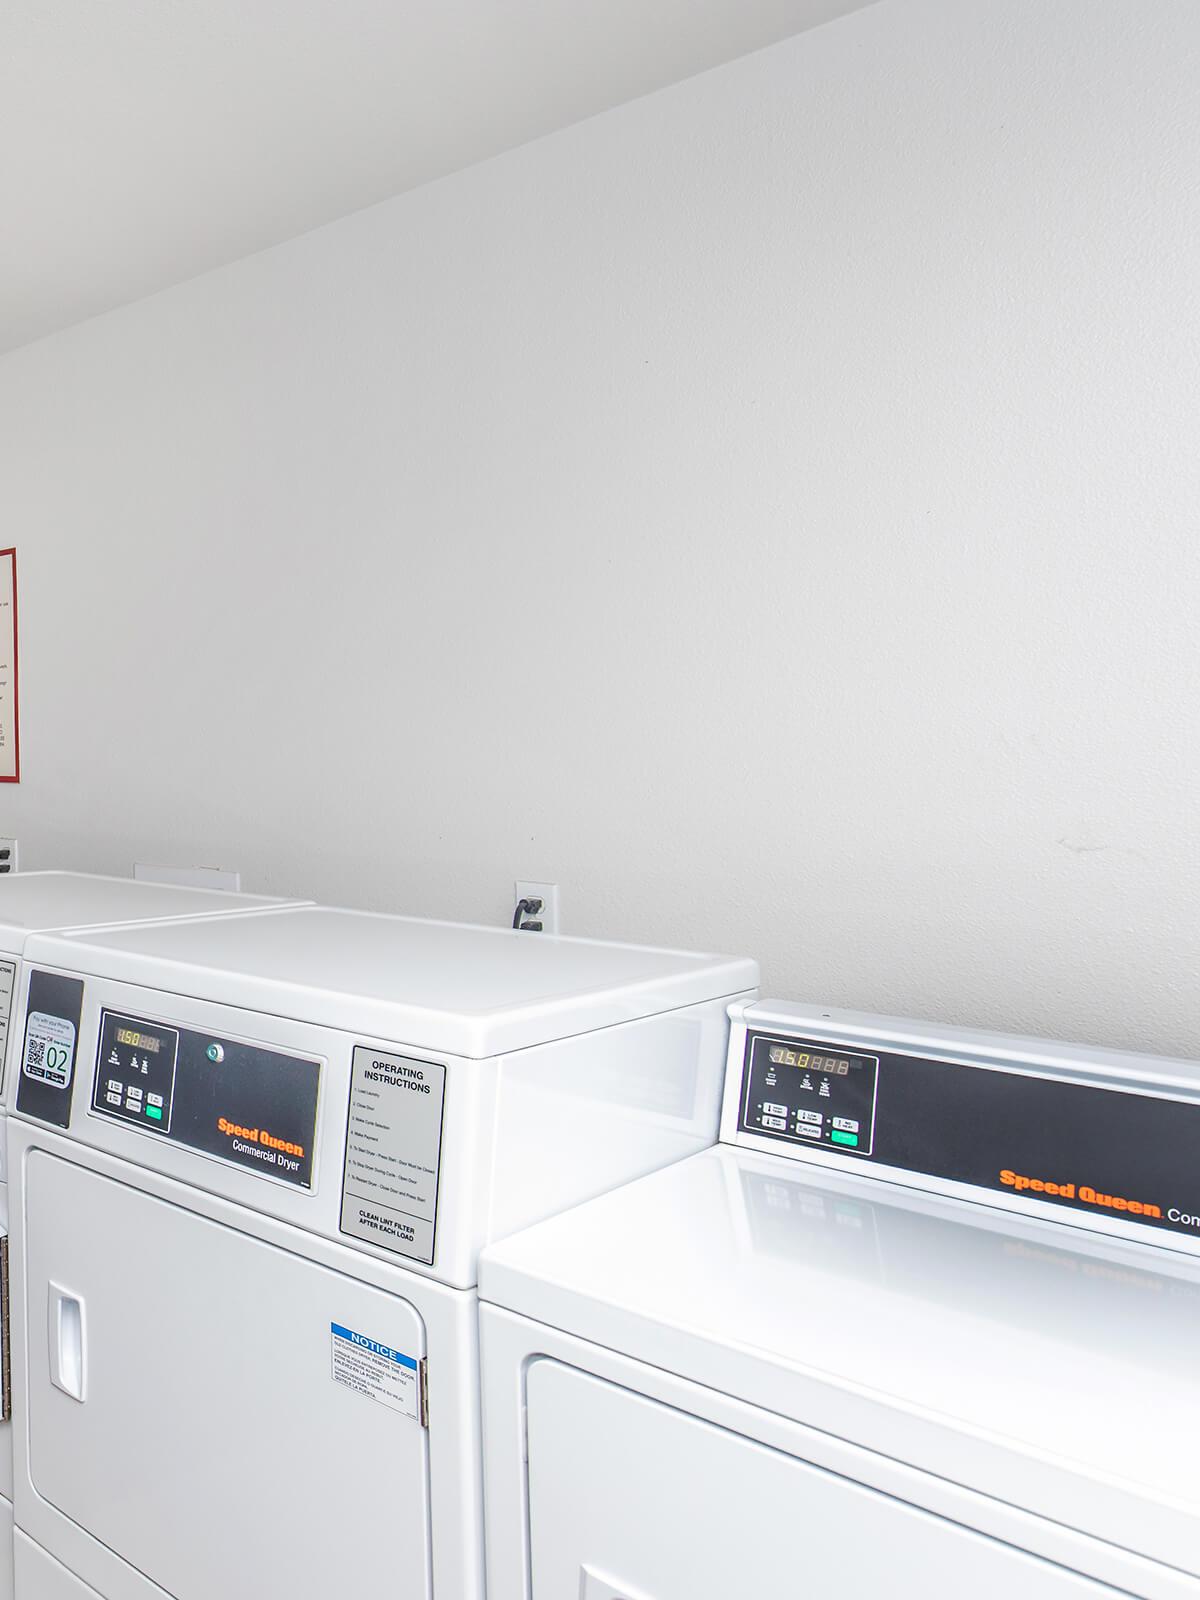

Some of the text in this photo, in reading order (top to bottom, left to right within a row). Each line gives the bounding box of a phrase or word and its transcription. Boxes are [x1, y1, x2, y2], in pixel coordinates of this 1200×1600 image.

[47, 1047, 67, 1072] 02
[372, 1061, 424, 1080] OPERATING
[364, 1070, 430, 1094] INSTRUCTIONS
[218, 1118, 304, 1157] Speed Queen
[232, 1139, 300, 1171] Commercial Dryer
[1000, 1169, 1075, 1199] Speed
[1078, 1186, 1161, 1219] Queen
[359, 1210, 415, 1234] CLEAN LINT FILTER
[359, 1218, 414, 1241] AFTER EACH LOAD
[351, 1333, 397, 1360] NOTICE
